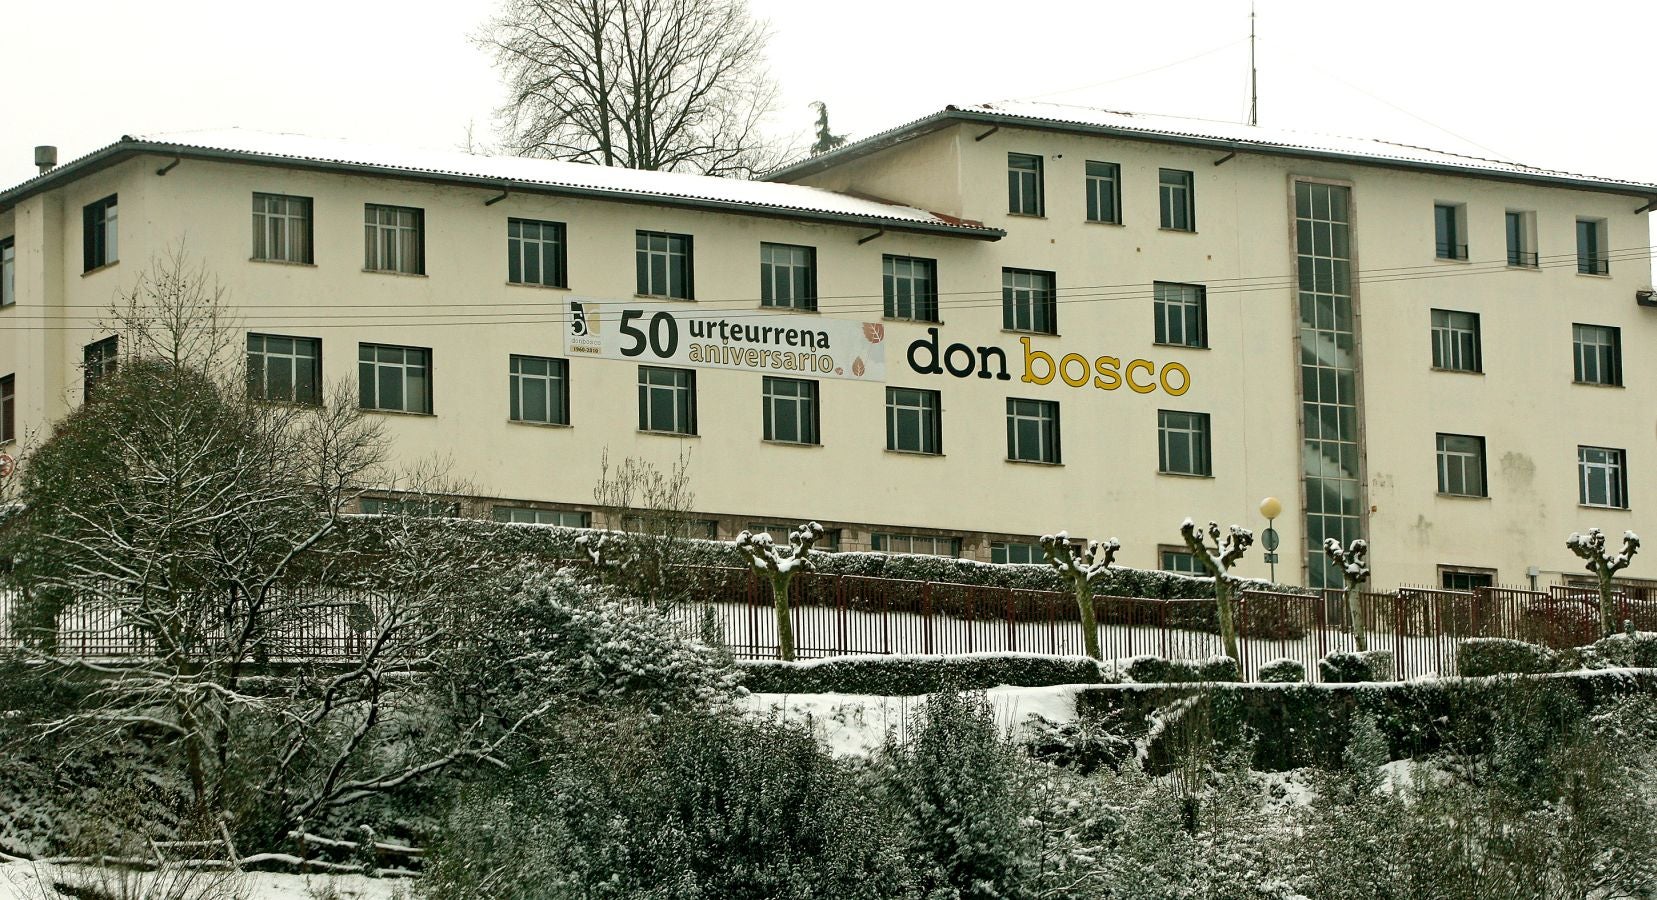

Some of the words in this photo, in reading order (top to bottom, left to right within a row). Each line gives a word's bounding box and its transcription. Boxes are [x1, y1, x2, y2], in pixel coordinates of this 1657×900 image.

[619, 309, 679, 359] 50
[689, 319, 831, 350] urteurrena
[688, 338, 834, 374] aniversario
[907, 327, 1011, 381] don
[1019, 336, 1191, 397] bosco
